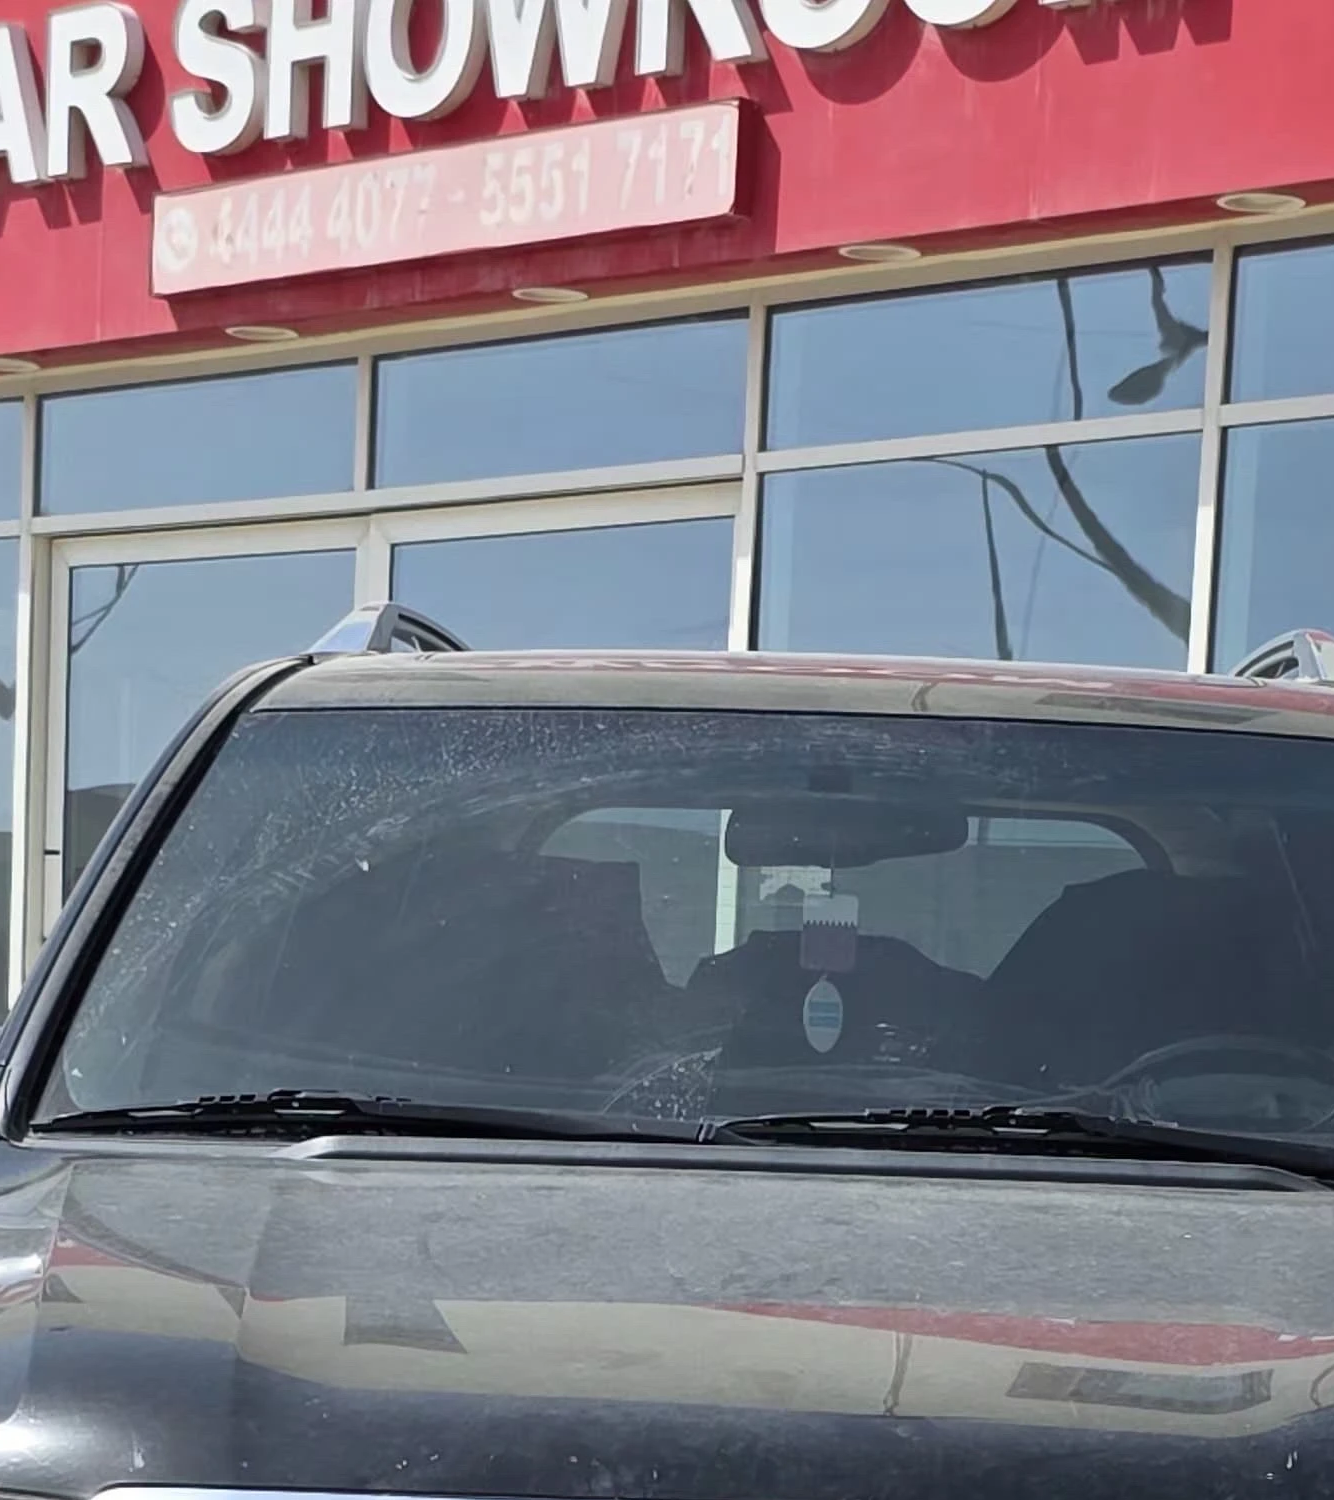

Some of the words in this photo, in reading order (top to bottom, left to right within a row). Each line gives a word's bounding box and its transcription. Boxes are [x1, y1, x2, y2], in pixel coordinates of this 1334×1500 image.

[170, 0, 1092, 154] SHOW
[478, 136, 591, 227] 5551
[615, 112, 735, 210] 7171
